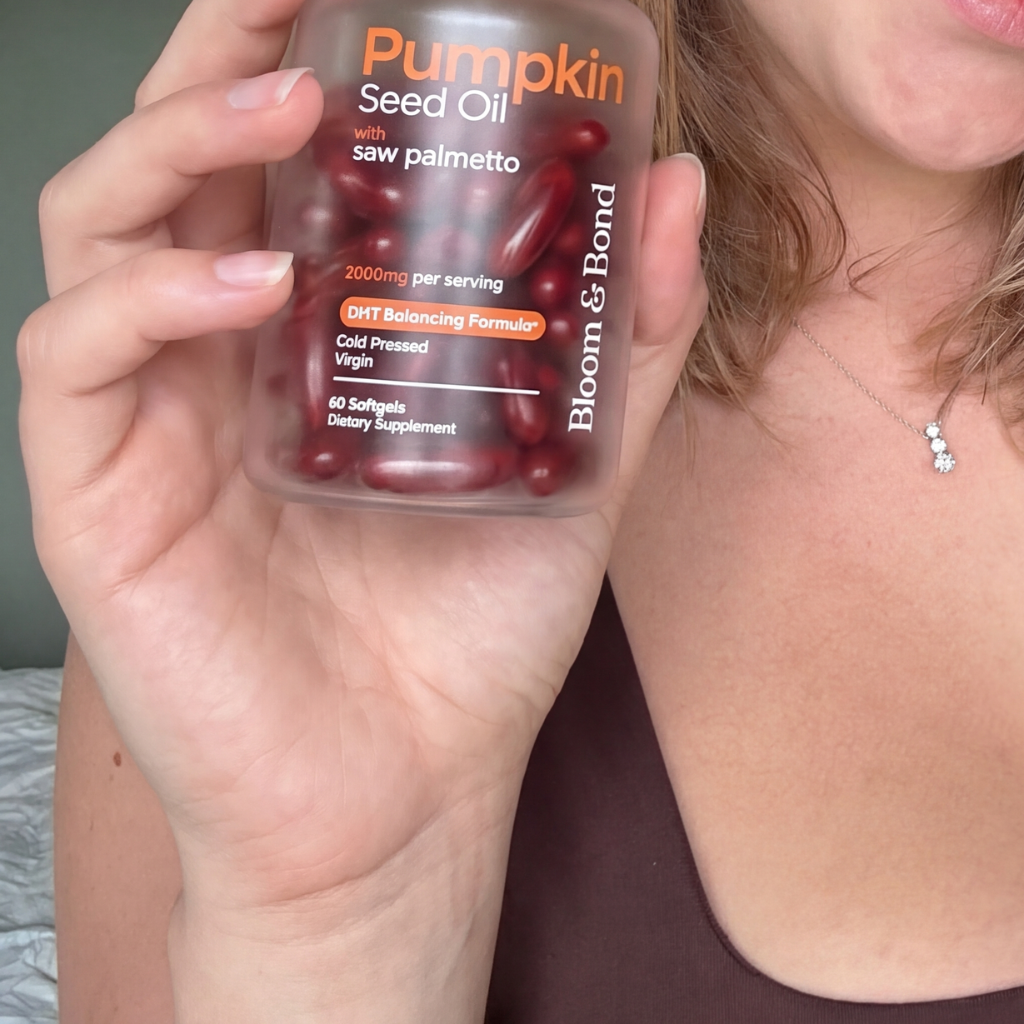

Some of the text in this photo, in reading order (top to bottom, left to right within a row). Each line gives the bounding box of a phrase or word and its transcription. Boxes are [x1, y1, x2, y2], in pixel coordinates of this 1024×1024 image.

[362, 27, 624, 104] Pumpkin
[358, 83, 508, 124] Seed Oil
[354, 126, 386, 141] with
[352, 144, 520, 174] saw palmetto
[345, 265, 504, 294] 2000mg per serving
[383, 307, 465, 331] Balancing
[568, 183, 616, 434] Bloom & Bond
[336, 334, 430, 354] Cold Pressed
[335, 352, 374, 371] Virgin
[328, 396, 406, 417] 60 Softgels
[327, 413, 457, 435] Dietary Supplement
